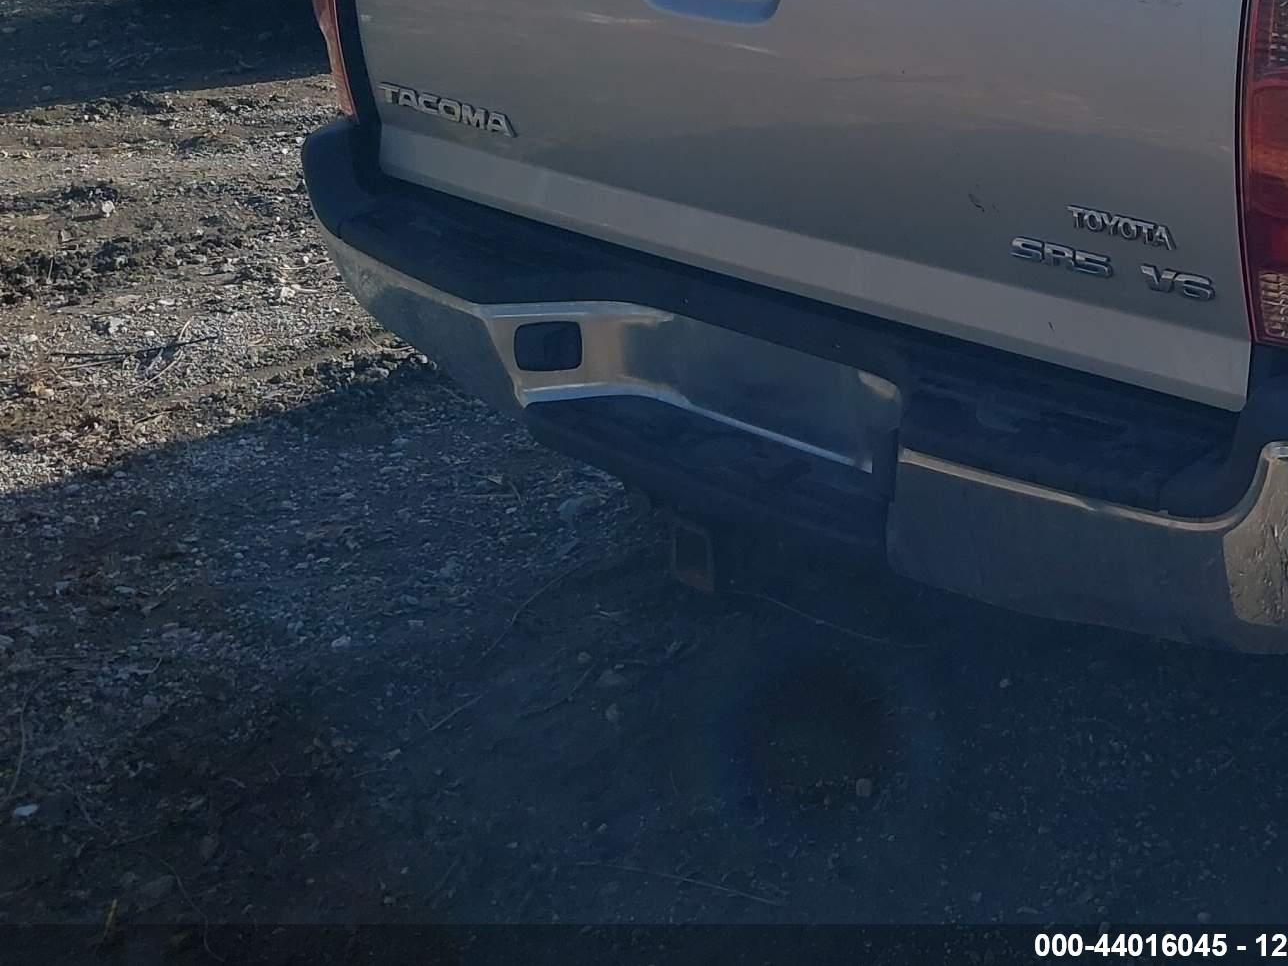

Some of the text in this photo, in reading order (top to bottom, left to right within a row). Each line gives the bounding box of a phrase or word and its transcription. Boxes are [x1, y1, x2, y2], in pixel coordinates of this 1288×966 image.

[378, 81, 519, 138] TACOMA
[1067, 204, 1176, 251] TOYOTA
[1010, 236, 1216, 302] SR5 V6
